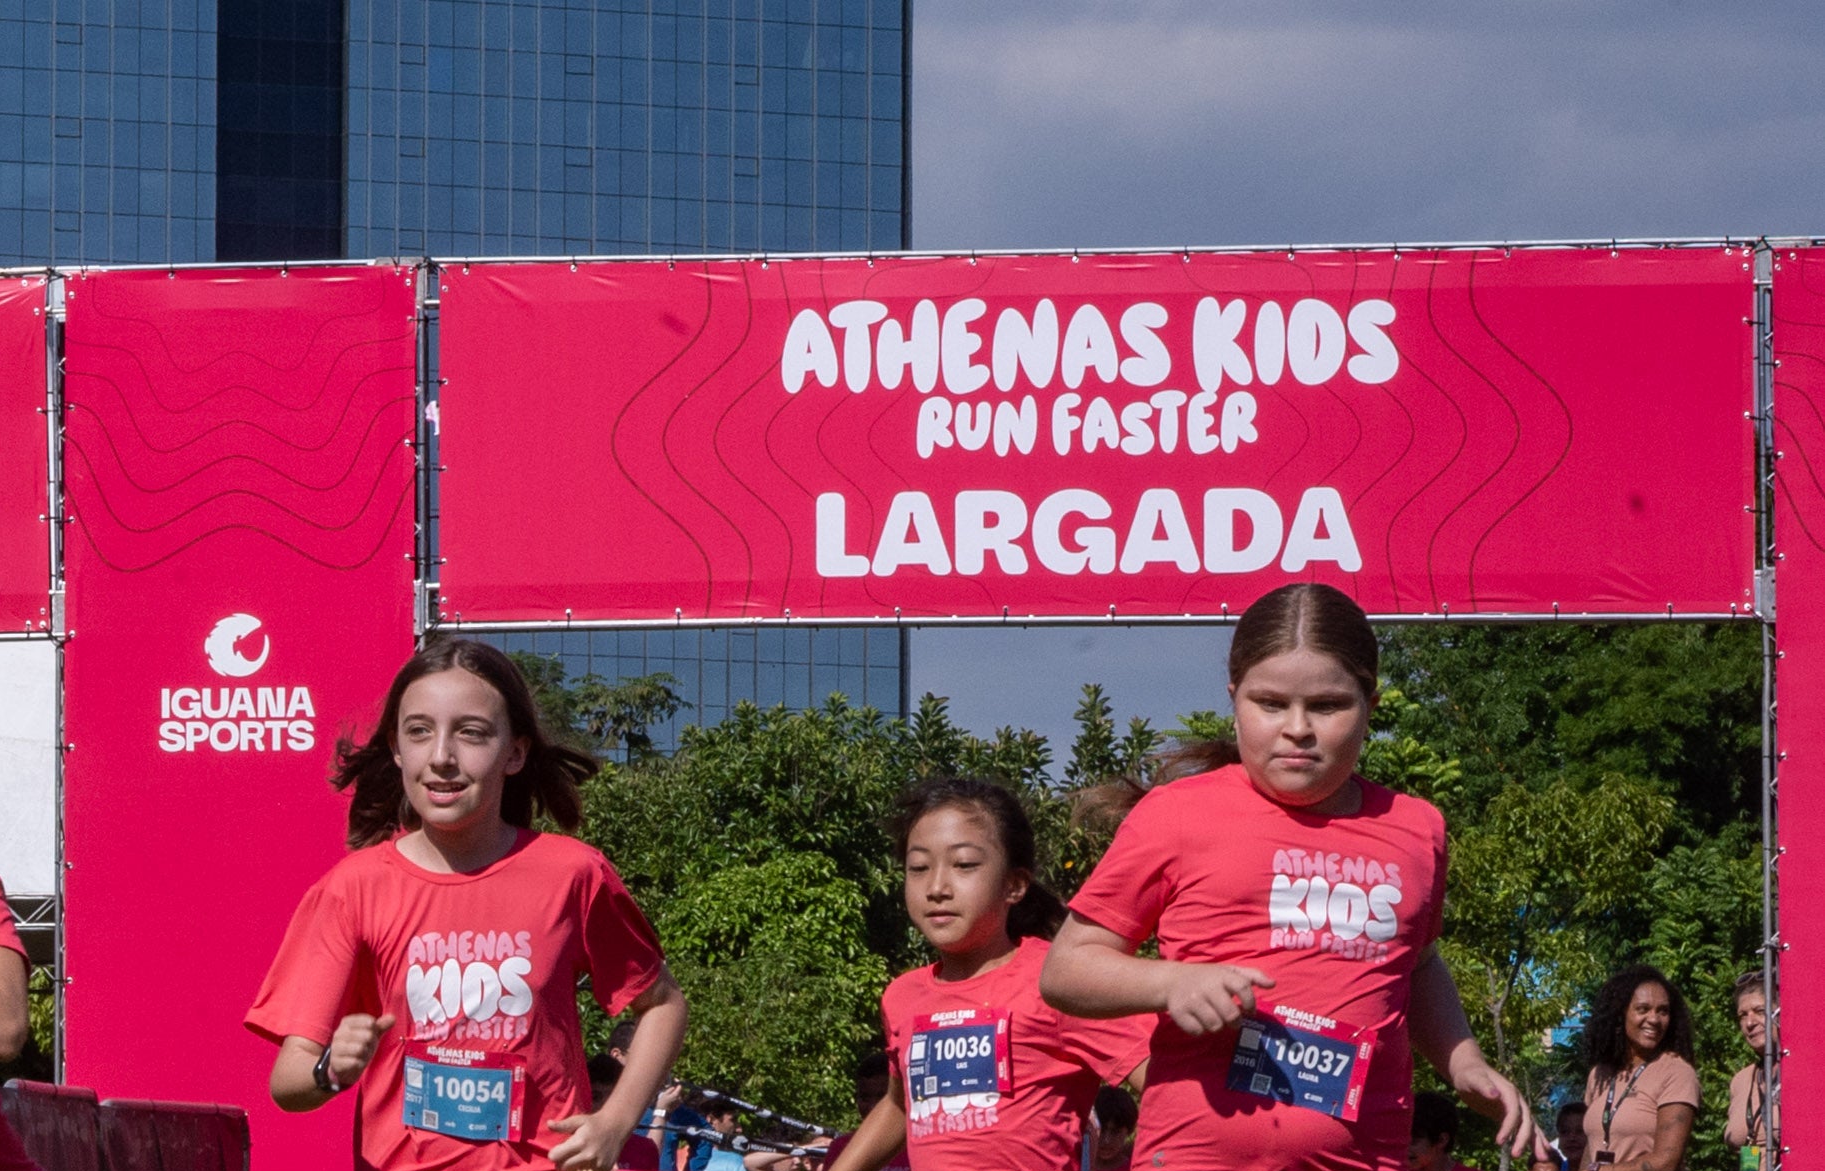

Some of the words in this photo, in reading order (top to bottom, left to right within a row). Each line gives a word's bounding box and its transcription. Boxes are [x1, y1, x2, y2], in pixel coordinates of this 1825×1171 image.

[781, 297, 1172, 395] ATHENAS
[1192, 296, 1400, 394] KIDS
[916, 394, 1038, 459] RUN
[1051, 390, 1259, 456] FASTER
[815, 486, 1363, 578] LARGADA
[160, 686, 316, 719] IGUANA
[158, 719, 315, 753] SPORTS
[1272, 848, 1402, 889] ATHENAS
[1269, 873, 1403, 943] KIDS
[408, 930, 532, 965] ATHENAS
[1270, 928, 1315, 950] RUN
[1320, 932, 1389, 964] FASTER
[406, 956, 533, 1026] KIDS
[455, 1016, 528, 1041] FASTER
[934, 1034, 992, 1061] 10036
[1275, 1037, 1351, 1077] 10037
[433, 1075, 507, 1103] 10054
[937, 1106, 999, 1134] FASTER
